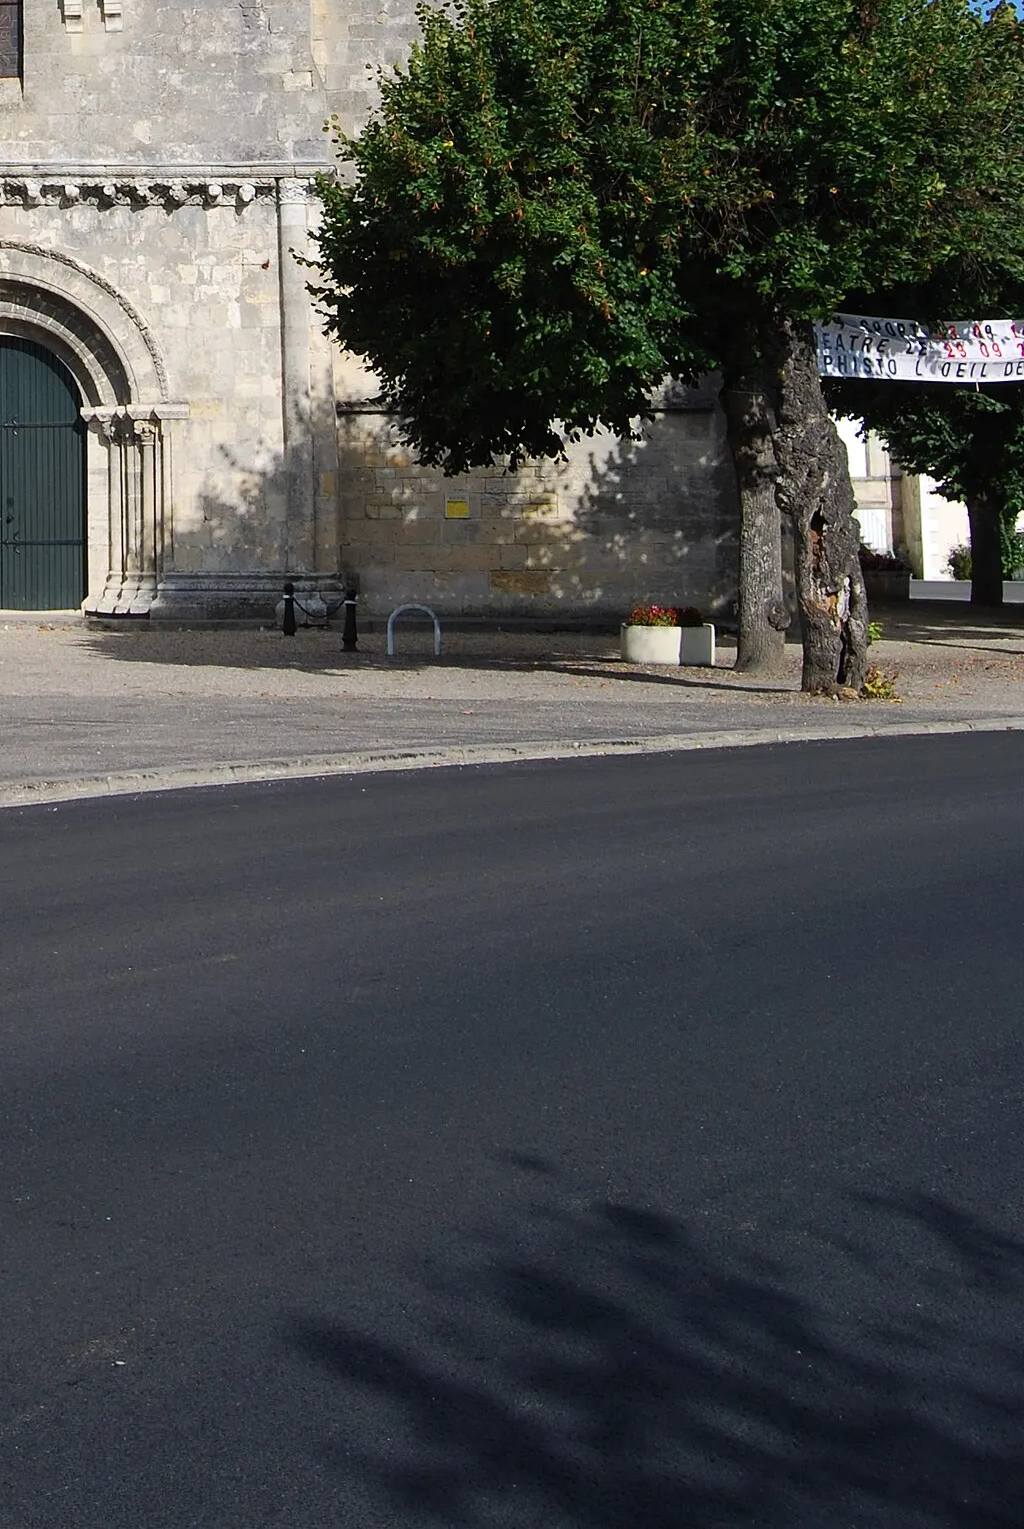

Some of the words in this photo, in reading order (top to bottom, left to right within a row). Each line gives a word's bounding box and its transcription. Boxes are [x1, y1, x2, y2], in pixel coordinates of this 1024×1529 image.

[944, 342, 966, 358] 29
[979, 342, 1002, 358] 09
[941, 362, 987, 378] OEIL
